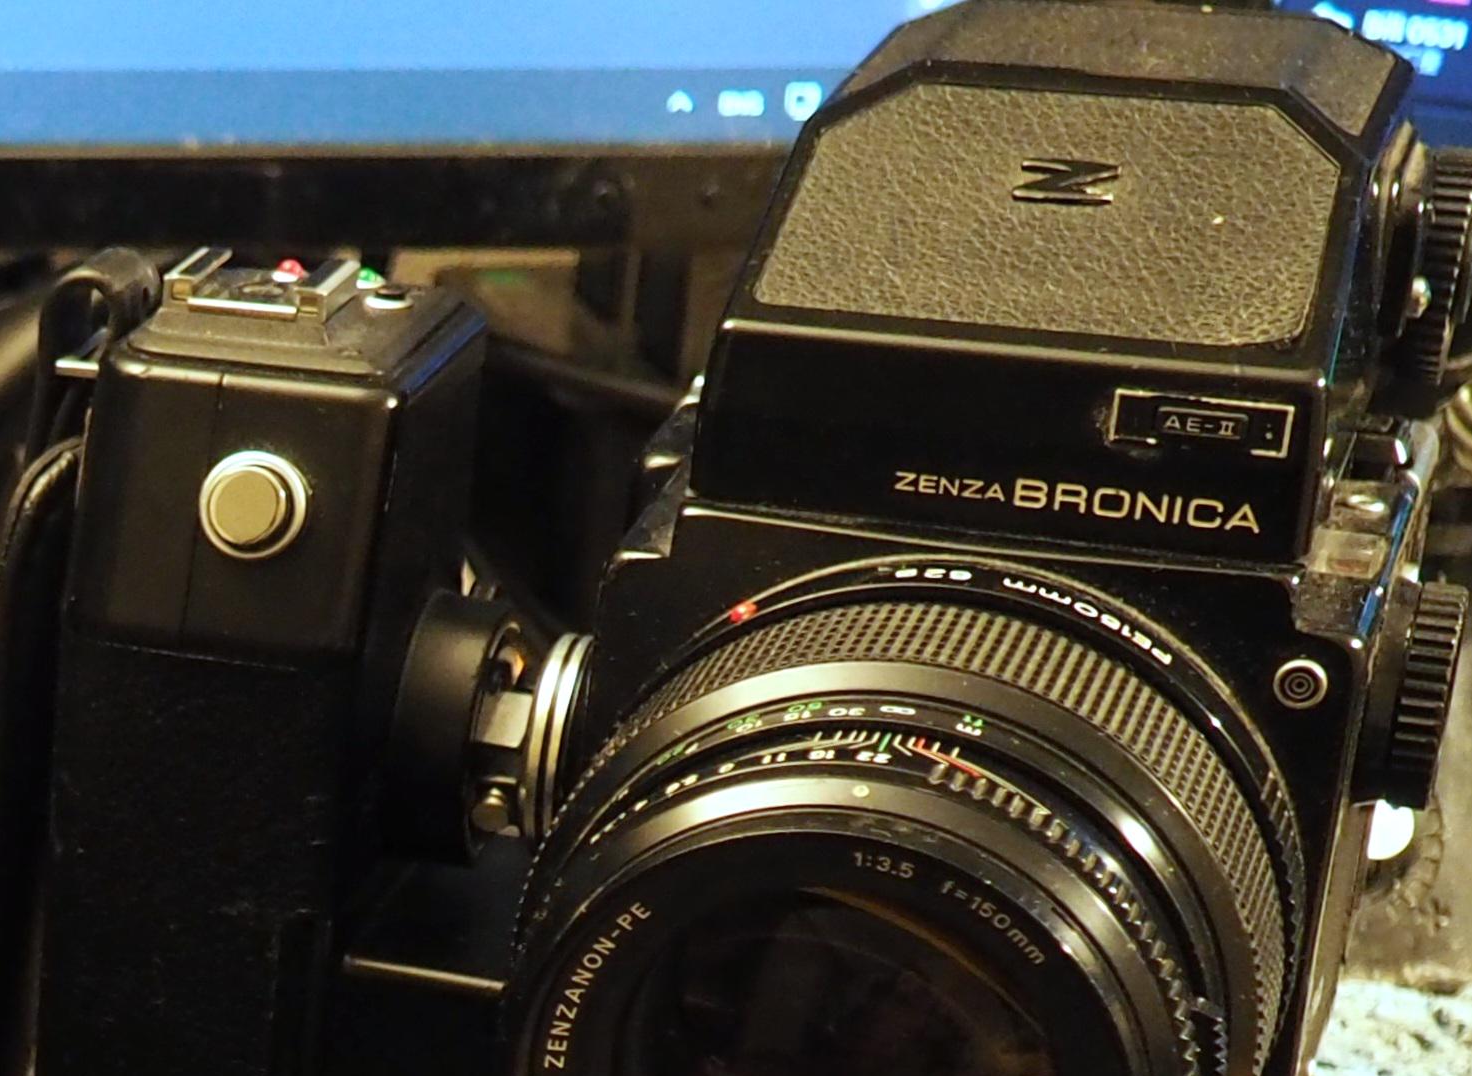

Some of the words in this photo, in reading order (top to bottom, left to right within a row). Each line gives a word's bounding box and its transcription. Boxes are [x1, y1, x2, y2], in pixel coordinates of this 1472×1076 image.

[894, 470, 1006, 502] ZENZA
[1013, 478, 1261, 535] BRONICA
[854, 851, 916, 880] 1:3.5
[543, 900, 653, 1071] ZENZANON-PE
